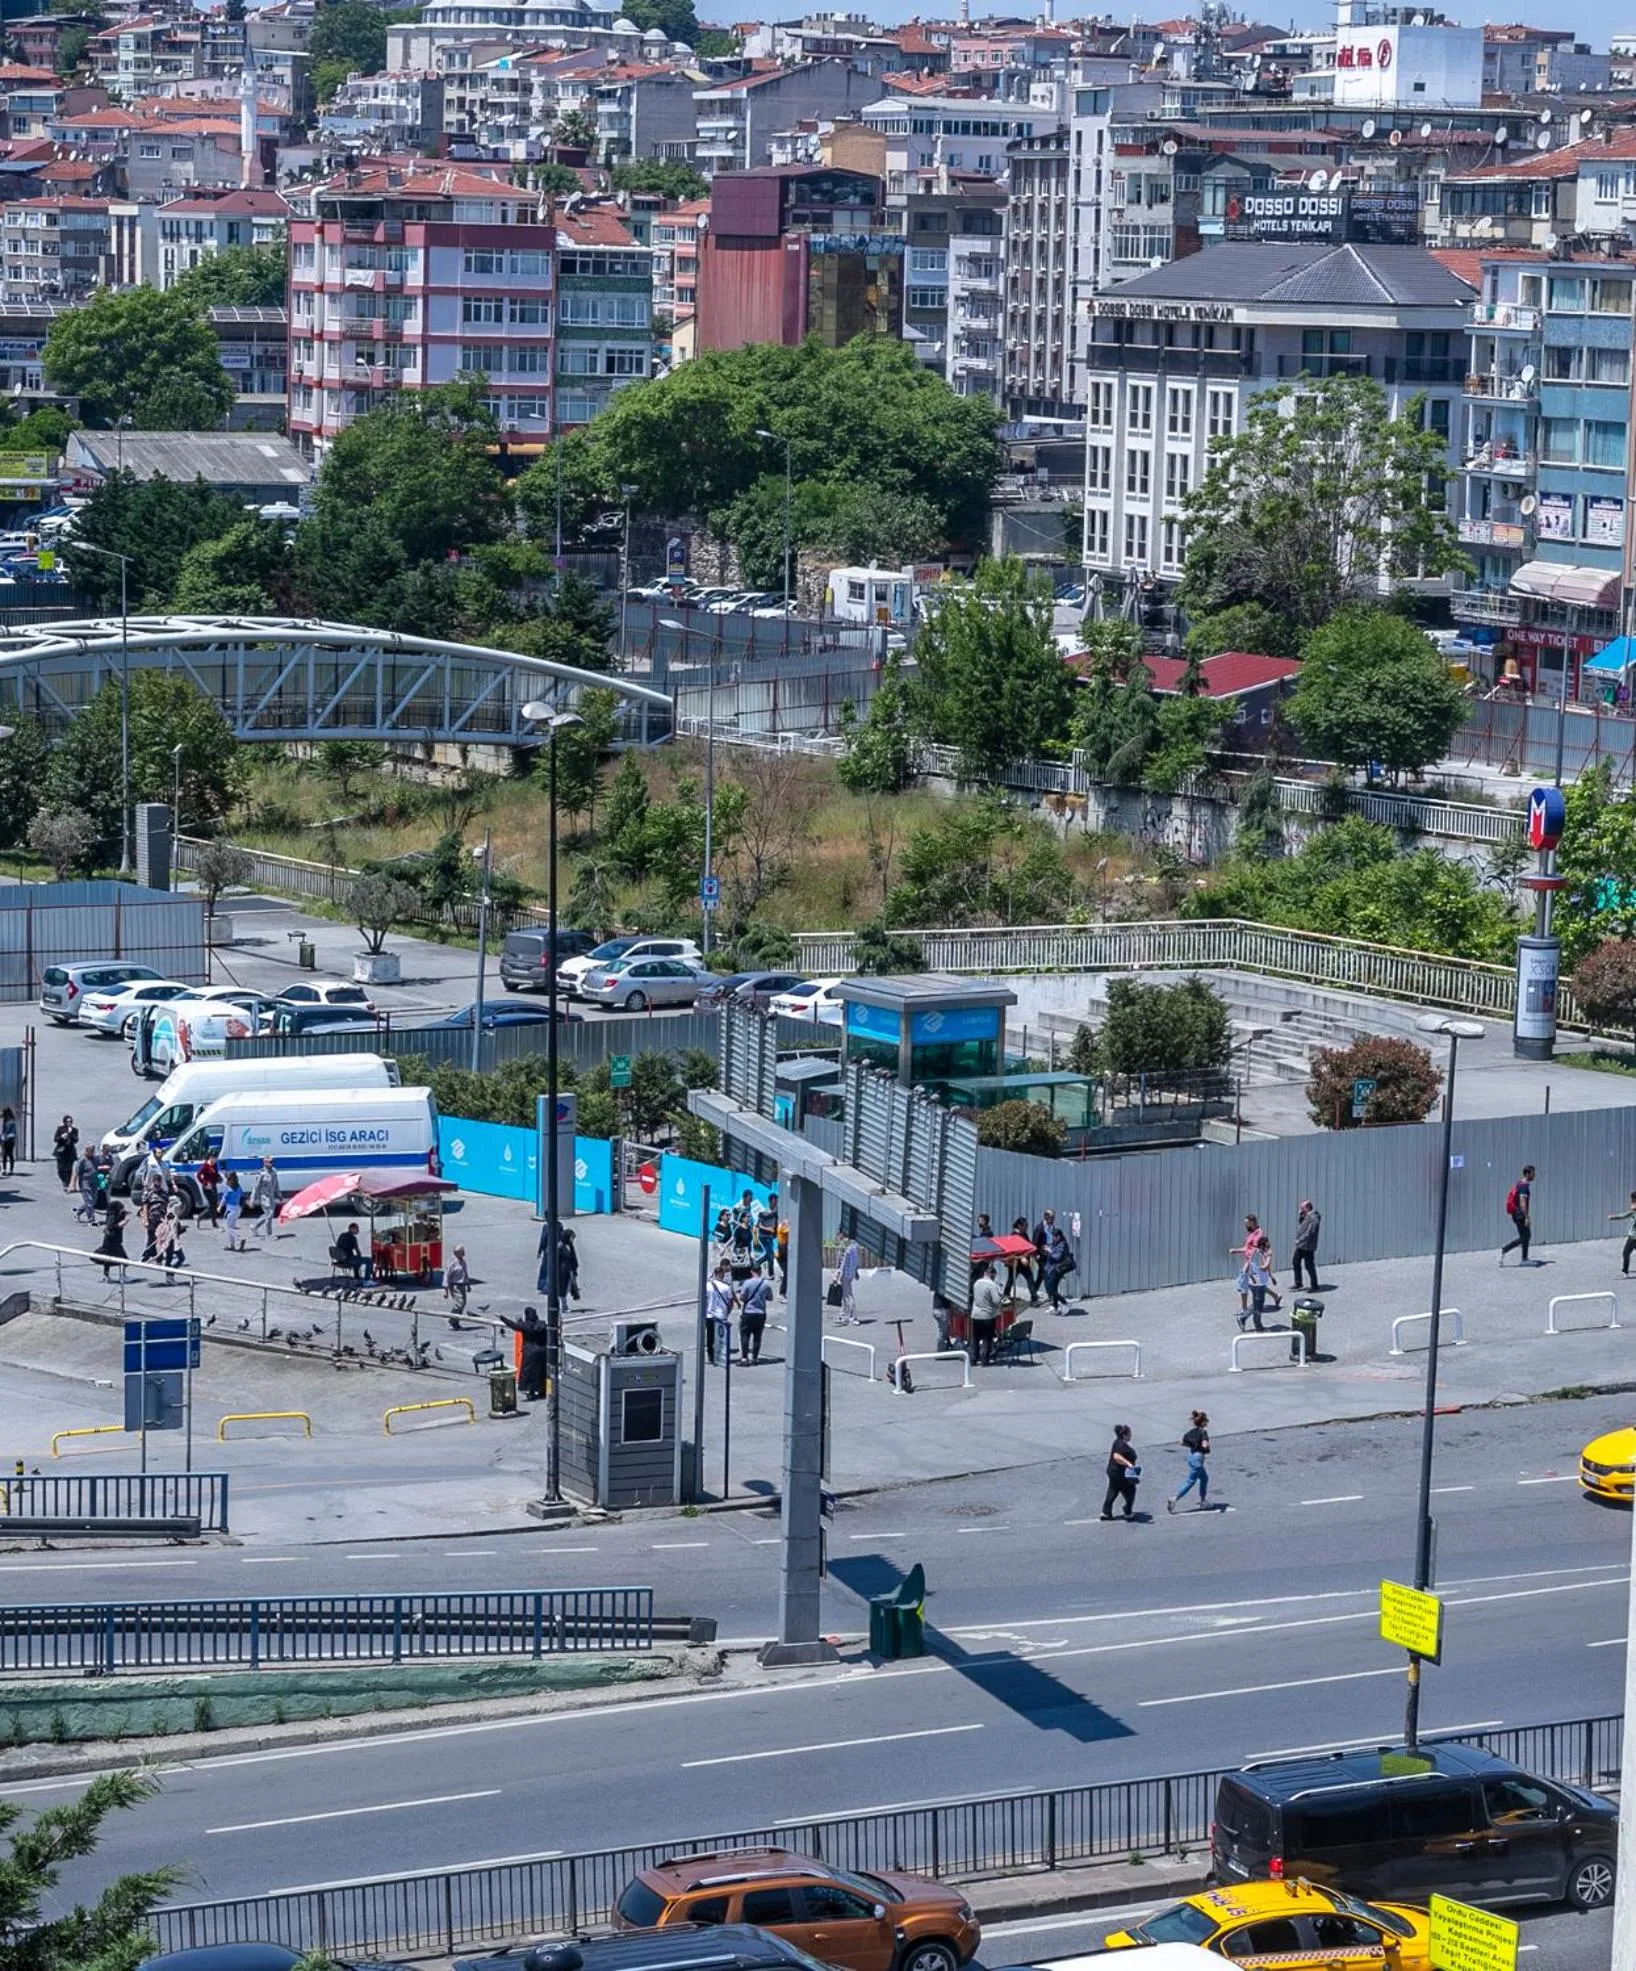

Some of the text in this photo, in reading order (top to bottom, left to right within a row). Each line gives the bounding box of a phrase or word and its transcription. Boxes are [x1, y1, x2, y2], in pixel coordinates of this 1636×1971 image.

[1245, 197, 1342, 215] DOSSO DOSSI
[1387, 199, 1417, 210] DOSSI
[1253, 217, 1332, 232] HOTELS YENİKAPI
[1099, 302, 1126, 315] DOSSO
[1129, 303, 1154, 316] DOSSI
[1157, 305, 1190, 318] HOTELS
[1507, 629, 1526, 641] ONE
[1528, 631, 1545, 643] WAY
[281, 1129, 322, 1144] GEZİCİ
[326, 1128, 347, 1143] İSG
[350, 1129, 389, 1142] ARACI
[1446, 1905, 1502, 1930] Ordu Caddesi
[1486, 1931, 1515, 1946] Projesi
